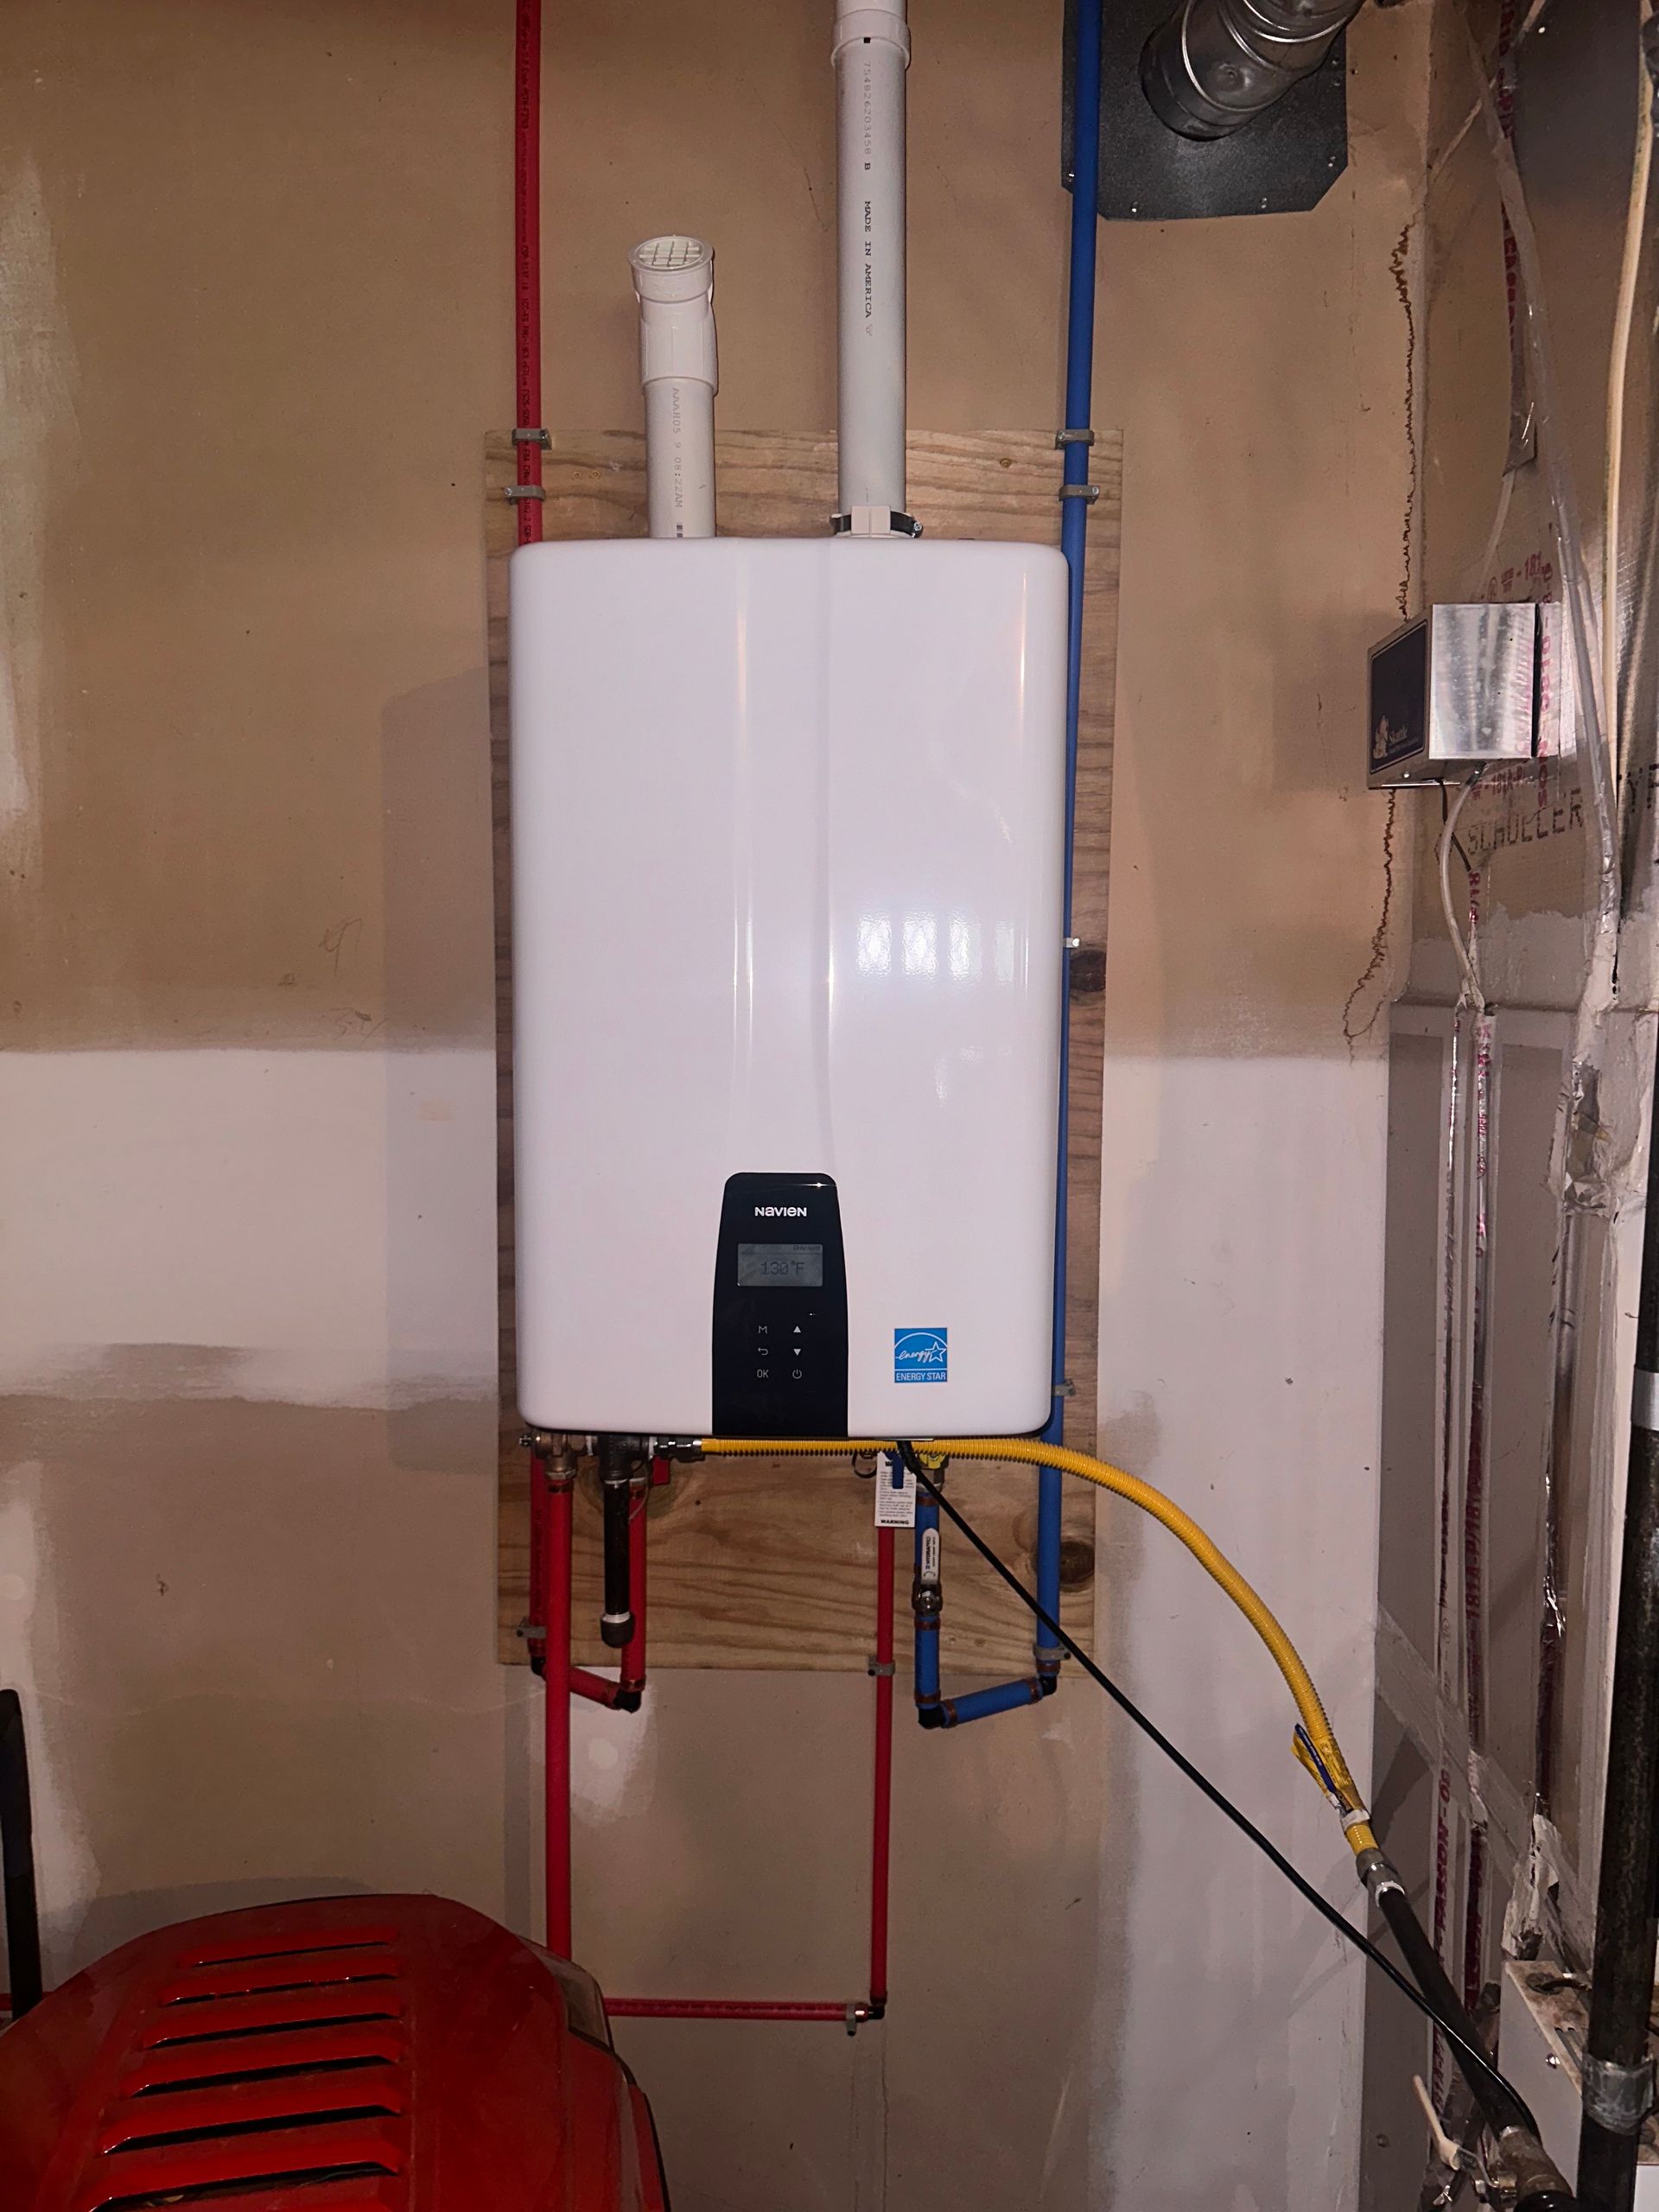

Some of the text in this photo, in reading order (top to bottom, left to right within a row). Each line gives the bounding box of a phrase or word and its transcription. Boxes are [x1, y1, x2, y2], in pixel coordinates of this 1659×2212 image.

[865, 240, 872, 257] IN
[758, 1325, 768, 1334] M
[756, 1369, 769, 1378] OK
[896, 1371, 946, 1381] ENERGY STAR
